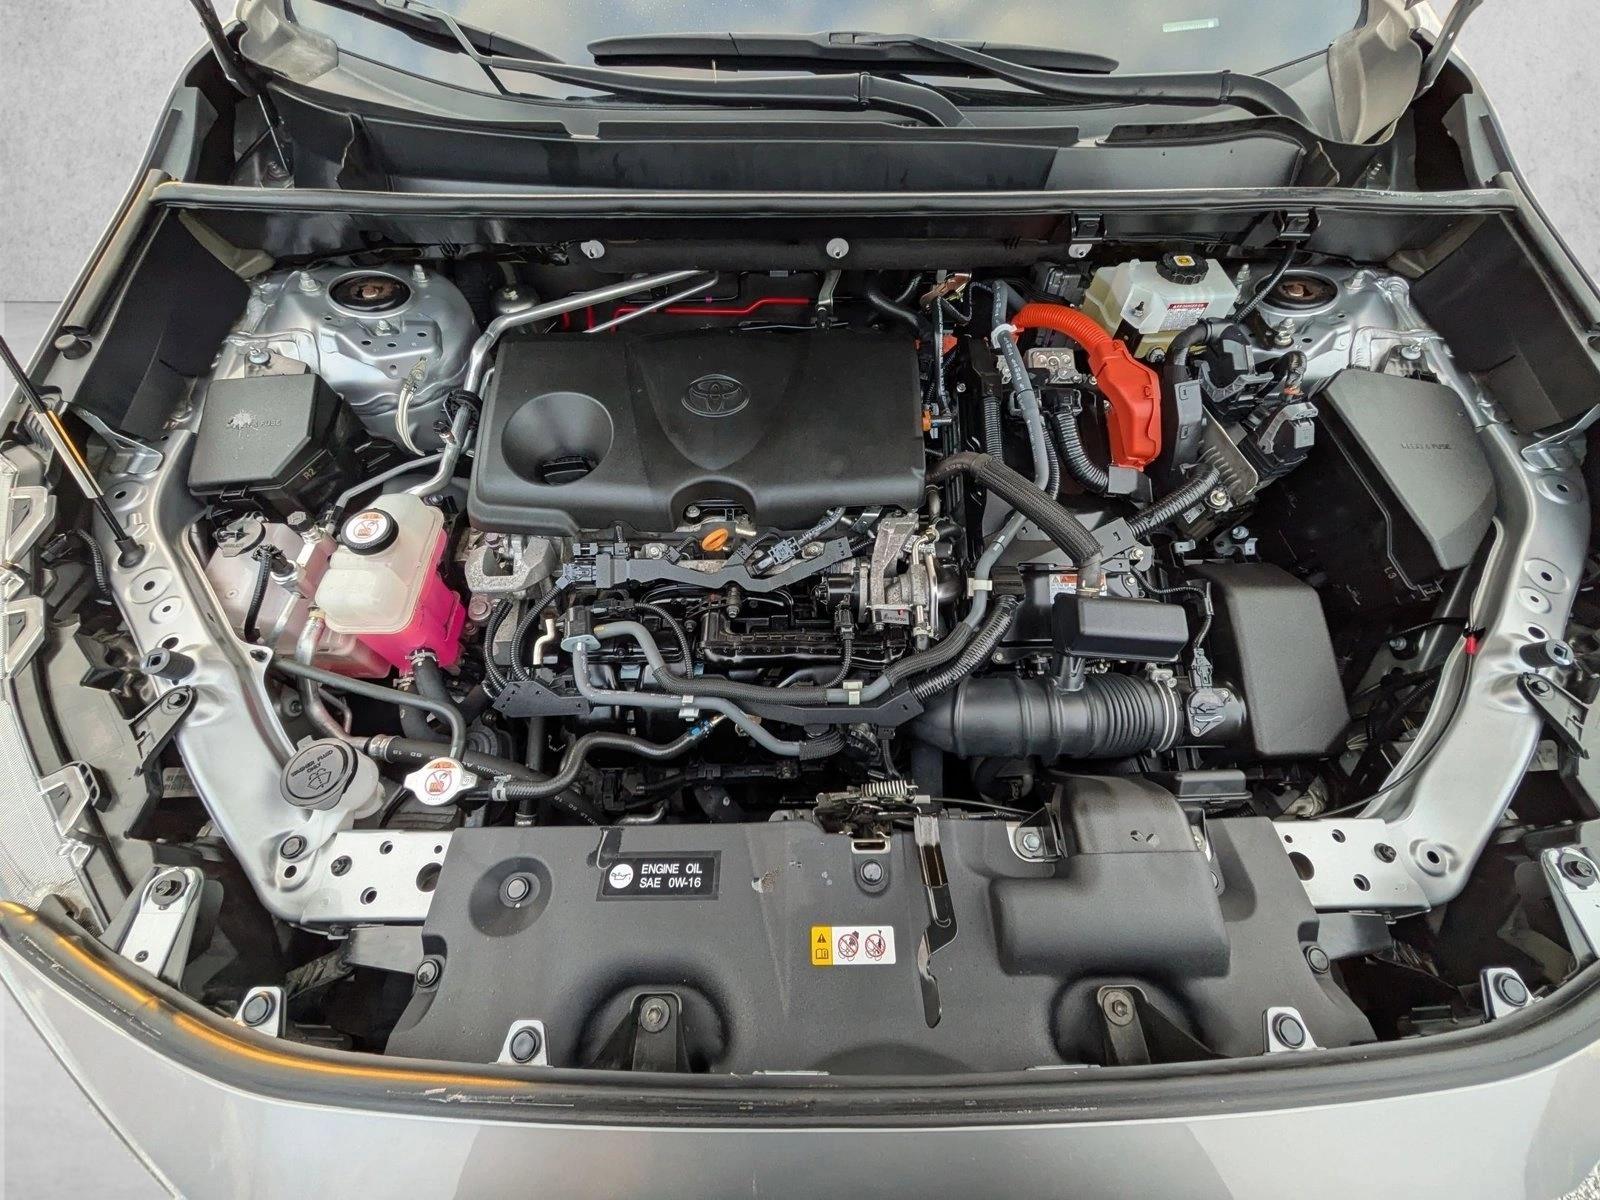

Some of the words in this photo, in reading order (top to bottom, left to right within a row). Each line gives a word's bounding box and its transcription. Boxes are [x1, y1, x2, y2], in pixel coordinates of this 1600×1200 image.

[316, 749, 334, 761] FLUID
[641, 863, 680, 874] ENGINE
[685, 863, 703, 874] OIL
[639, 877, 661, 888] SAE
[668, 877, 701, 888] 0W-16
